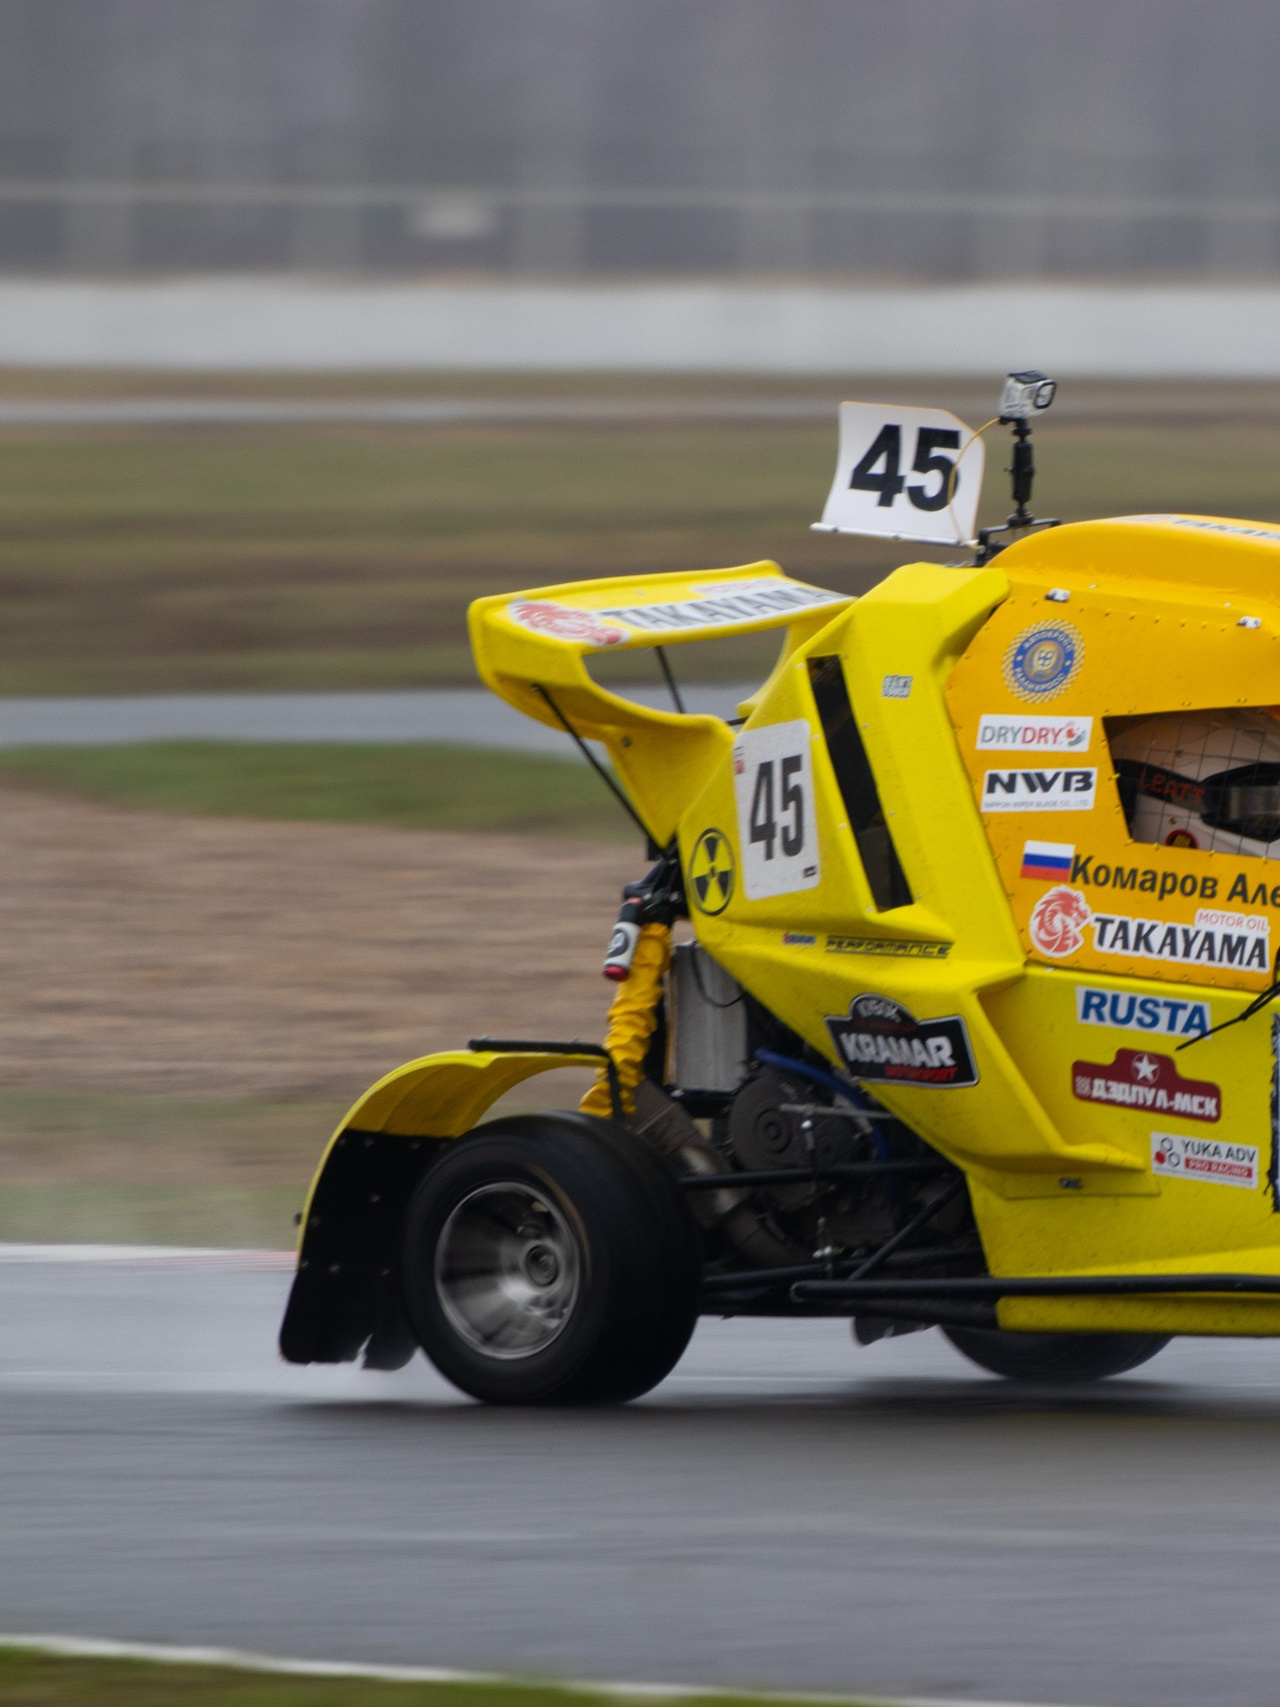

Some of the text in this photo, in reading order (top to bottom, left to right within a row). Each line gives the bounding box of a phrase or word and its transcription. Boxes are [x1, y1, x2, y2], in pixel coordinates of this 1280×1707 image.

[848, 425, 961, 511] 45
[981, 725, 1064, 745] DRYDRY
[986, 770, 1094, 794] NWB
[749, 754, 804, 861] 45
[1070, 854, 1218, 900] Комаров
[1200, 912, 1267, 931] MOTOR OIL
[1094, 916, 1267, 968] TAKAYAMA
[1081, 989, 1208, 1035] RUSTA
[840, 1033, 957, 1068] KRAMAR
[1091, 1078, 1218, 1118] ДЭДПУЛ-МСК
[1181, 1139, 1256, 1163] YUKA ADV
[1189, 1159, 1209, 1171] PRO
[1211, 1162, 1249, 1178] RACING
